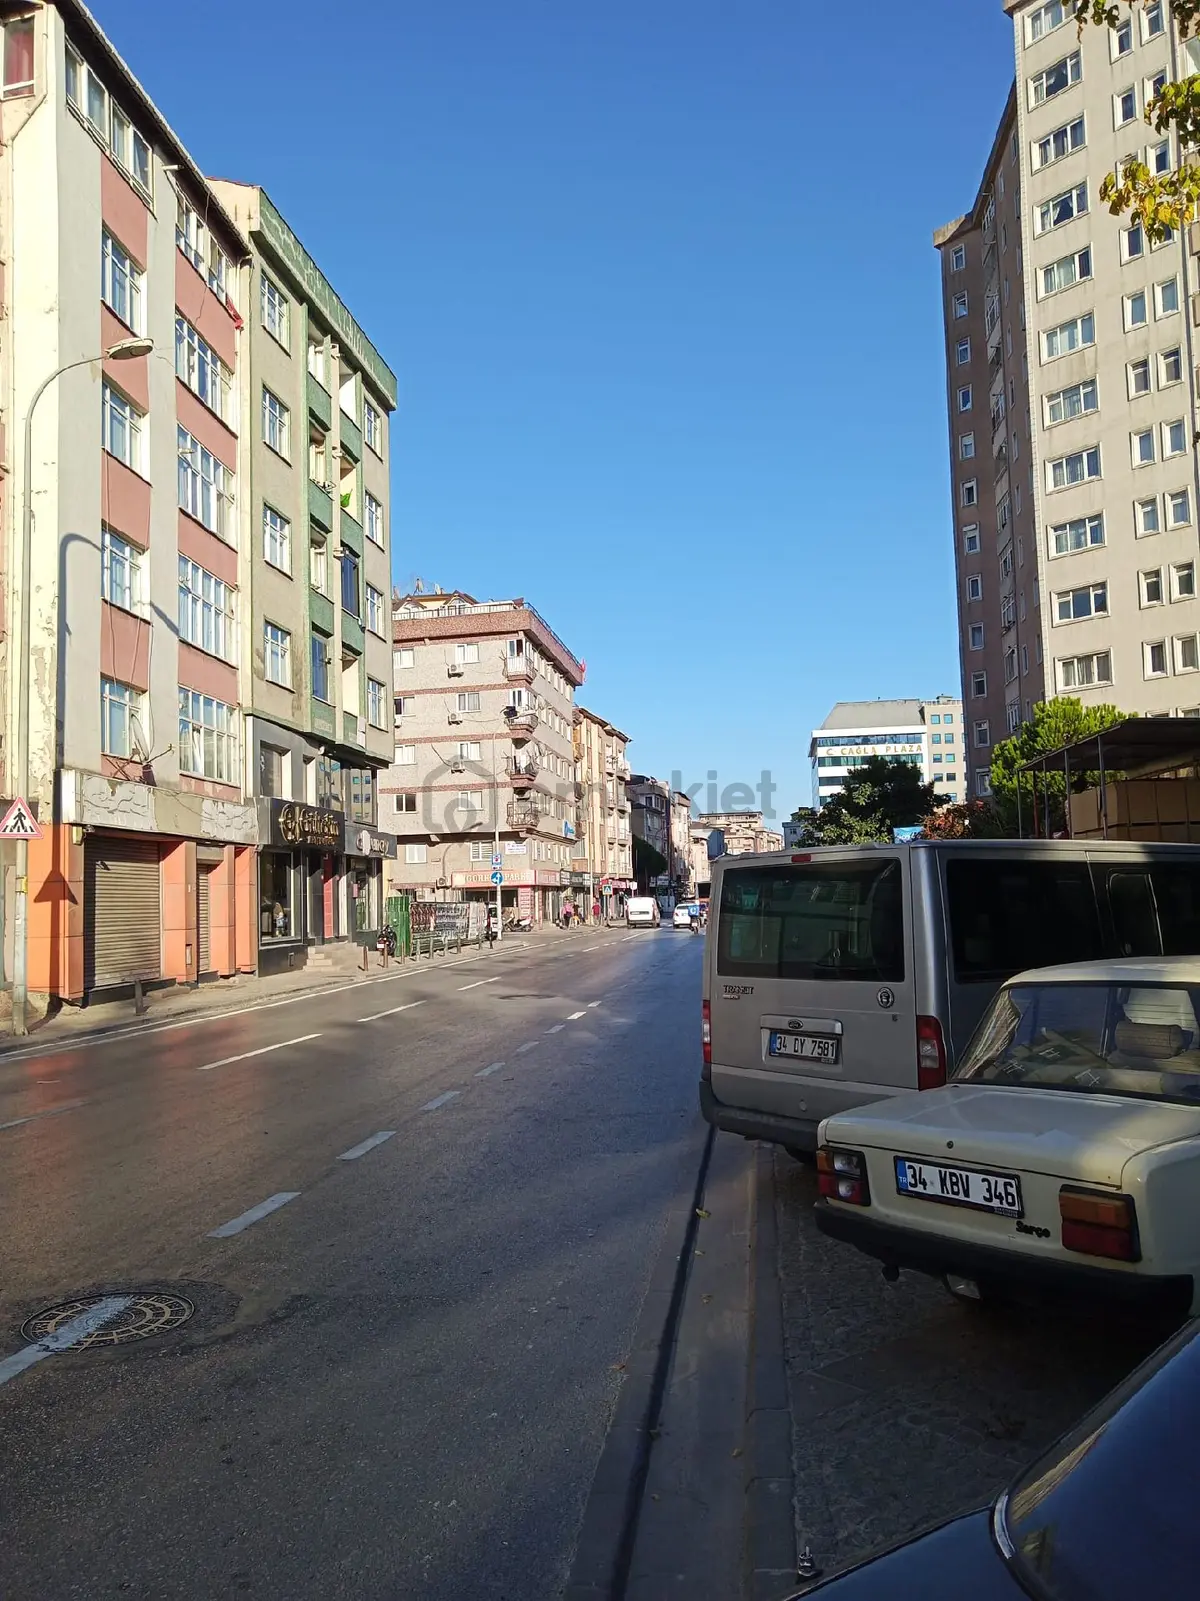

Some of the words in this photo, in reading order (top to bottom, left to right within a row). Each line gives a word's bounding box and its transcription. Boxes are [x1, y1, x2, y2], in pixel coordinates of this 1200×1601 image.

[885, 744, 922, 753] PLAZA
[776, 1035, 788, 1051] 34
[793, 1037, 806, 1054] DY
[811, 1040, 835, 1057] 7581
[907, 1164, 928, 1191] 34
[938, 1169, 971, 1199] KBV
[981, 1177, 1016, 1207] 346
